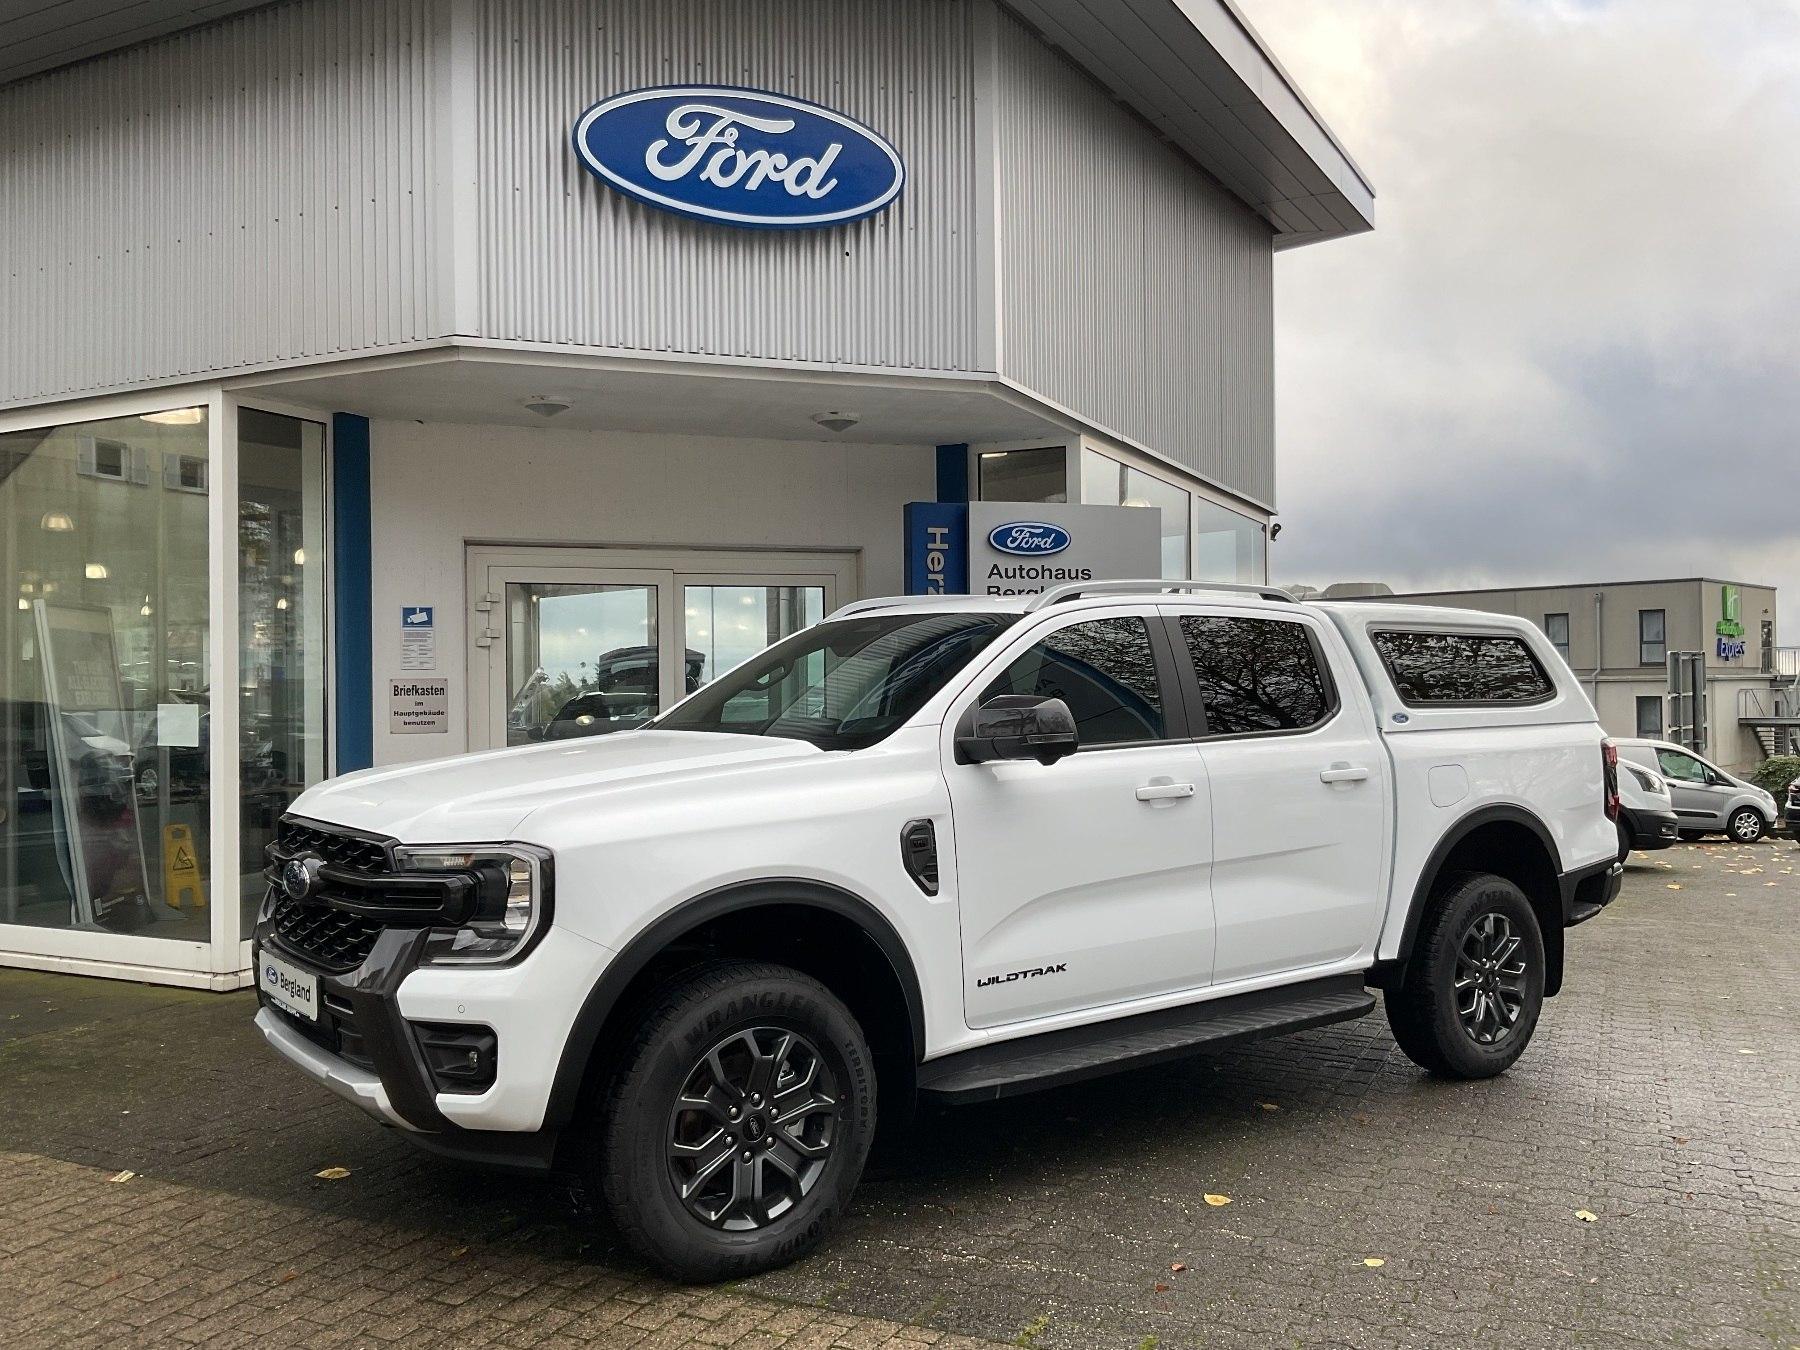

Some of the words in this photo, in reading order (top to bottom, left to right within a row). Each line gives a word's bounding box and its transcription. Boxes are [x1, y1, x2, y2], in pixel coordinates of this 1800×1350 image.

[645, 104, 843, 199] Ford
[1006, 526, 1056, 549] Ford
[987, 563, 1092, 580] Autohaus
[393, 684, 445, 696] Briefkasten
[393, 710, 445, 718] Hauptgebäude
[976, 962, 1067, 987] WILDTRAK
[280, 972, 311, 1003] Bergland
